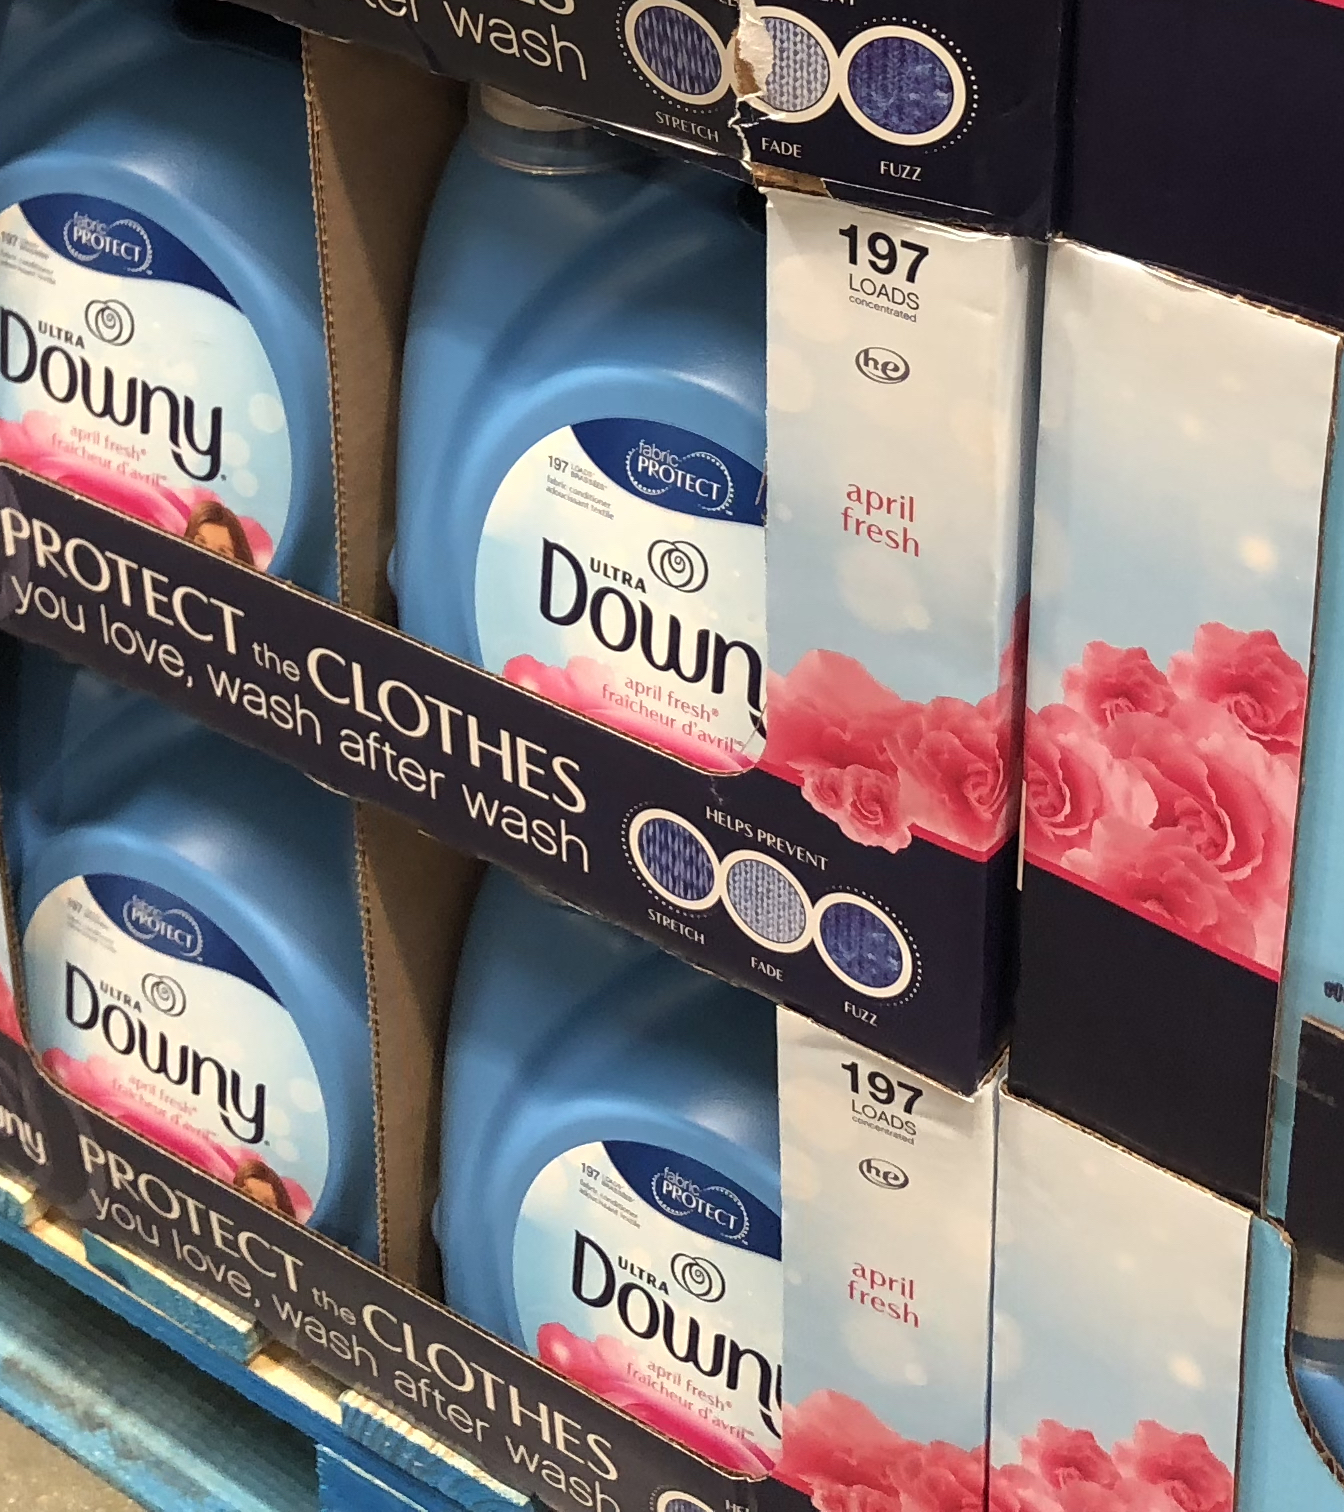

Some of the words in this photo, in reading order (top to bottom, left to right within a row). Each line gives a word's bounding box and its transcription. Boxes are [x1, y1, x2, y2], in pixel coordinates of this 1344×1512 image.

[655, 110, 720, 143] STRETCH
[761, 136, 802, 159] FADE
[879, 160, 923, 183] FUZZ
[72, 225, 143, 264] PROTECT
[838, 223, 930, 285] 197
[848, 274, 921, 311] LOADS
[848, 293, 918, 323] concentrated
[37, 319, 86, 350] ULTRA
[0, 305, 224, 482] Downy
[548, 454, 569, 474] 197
[638, 438, 680, 467] fabric
[636, 454, 722, 501] PROTECT
[845, 483, 916, 524] april
[841, 506, 920, 558] fresh
[589, 556, 646, 594] ULTRA
[0, 507, 246, 655] PROTECT
[251, 638, 302, 683] the
[307, 645, 587, 815] CLOTHES
[602, 683, 677, 729] fraîcheur
[625, 676, 662, 702] april
[10, 573, 86, 636] you
[101, 598, 194, 688] love,
[205, 661, 323, 748] wash
[338, 721, 446, 802] after
[461, 780, 592, 874] wash
[705, 805, 753, 839] HELPS
[757, 830, 829, 872] PREVENT
[647, 907, 706, 947] STRETCH
[750, 955, 785, 983] FADE
[100, 979, 142, 1013] ULTRA
[843, 1000, 879, 1028] FUZZ
[65, 961, 267, 1146] Downy
[840, 1060, 924, 1116] 197
[851, 1098, 918, 1138] LOADS
[851, 1115, 916, 1147] concentrated
[663, 1165, 702, 1195] fabric
[661, 1180, 739, 1233] PROTECT
[617, 1255, 670, 1296] ULTRA
[851, 1260, 916, 1302] april
[78, 1134, 305, 1293] PROTECT
[311, 1286, 358, 1326] the
[361, 1303, 620, 1482] CLOTHES
[846, 1279, 921, 1330] fresh
[89, 1188, 160, 1248] you
[171, 1228, 261, 1308] love,
[271, 1292, 380, 1378] wash
[392, 1369, 490, 1443] after
[504, 1434, 621, 1512] wash
[646, 1360, 684, 1387] april
